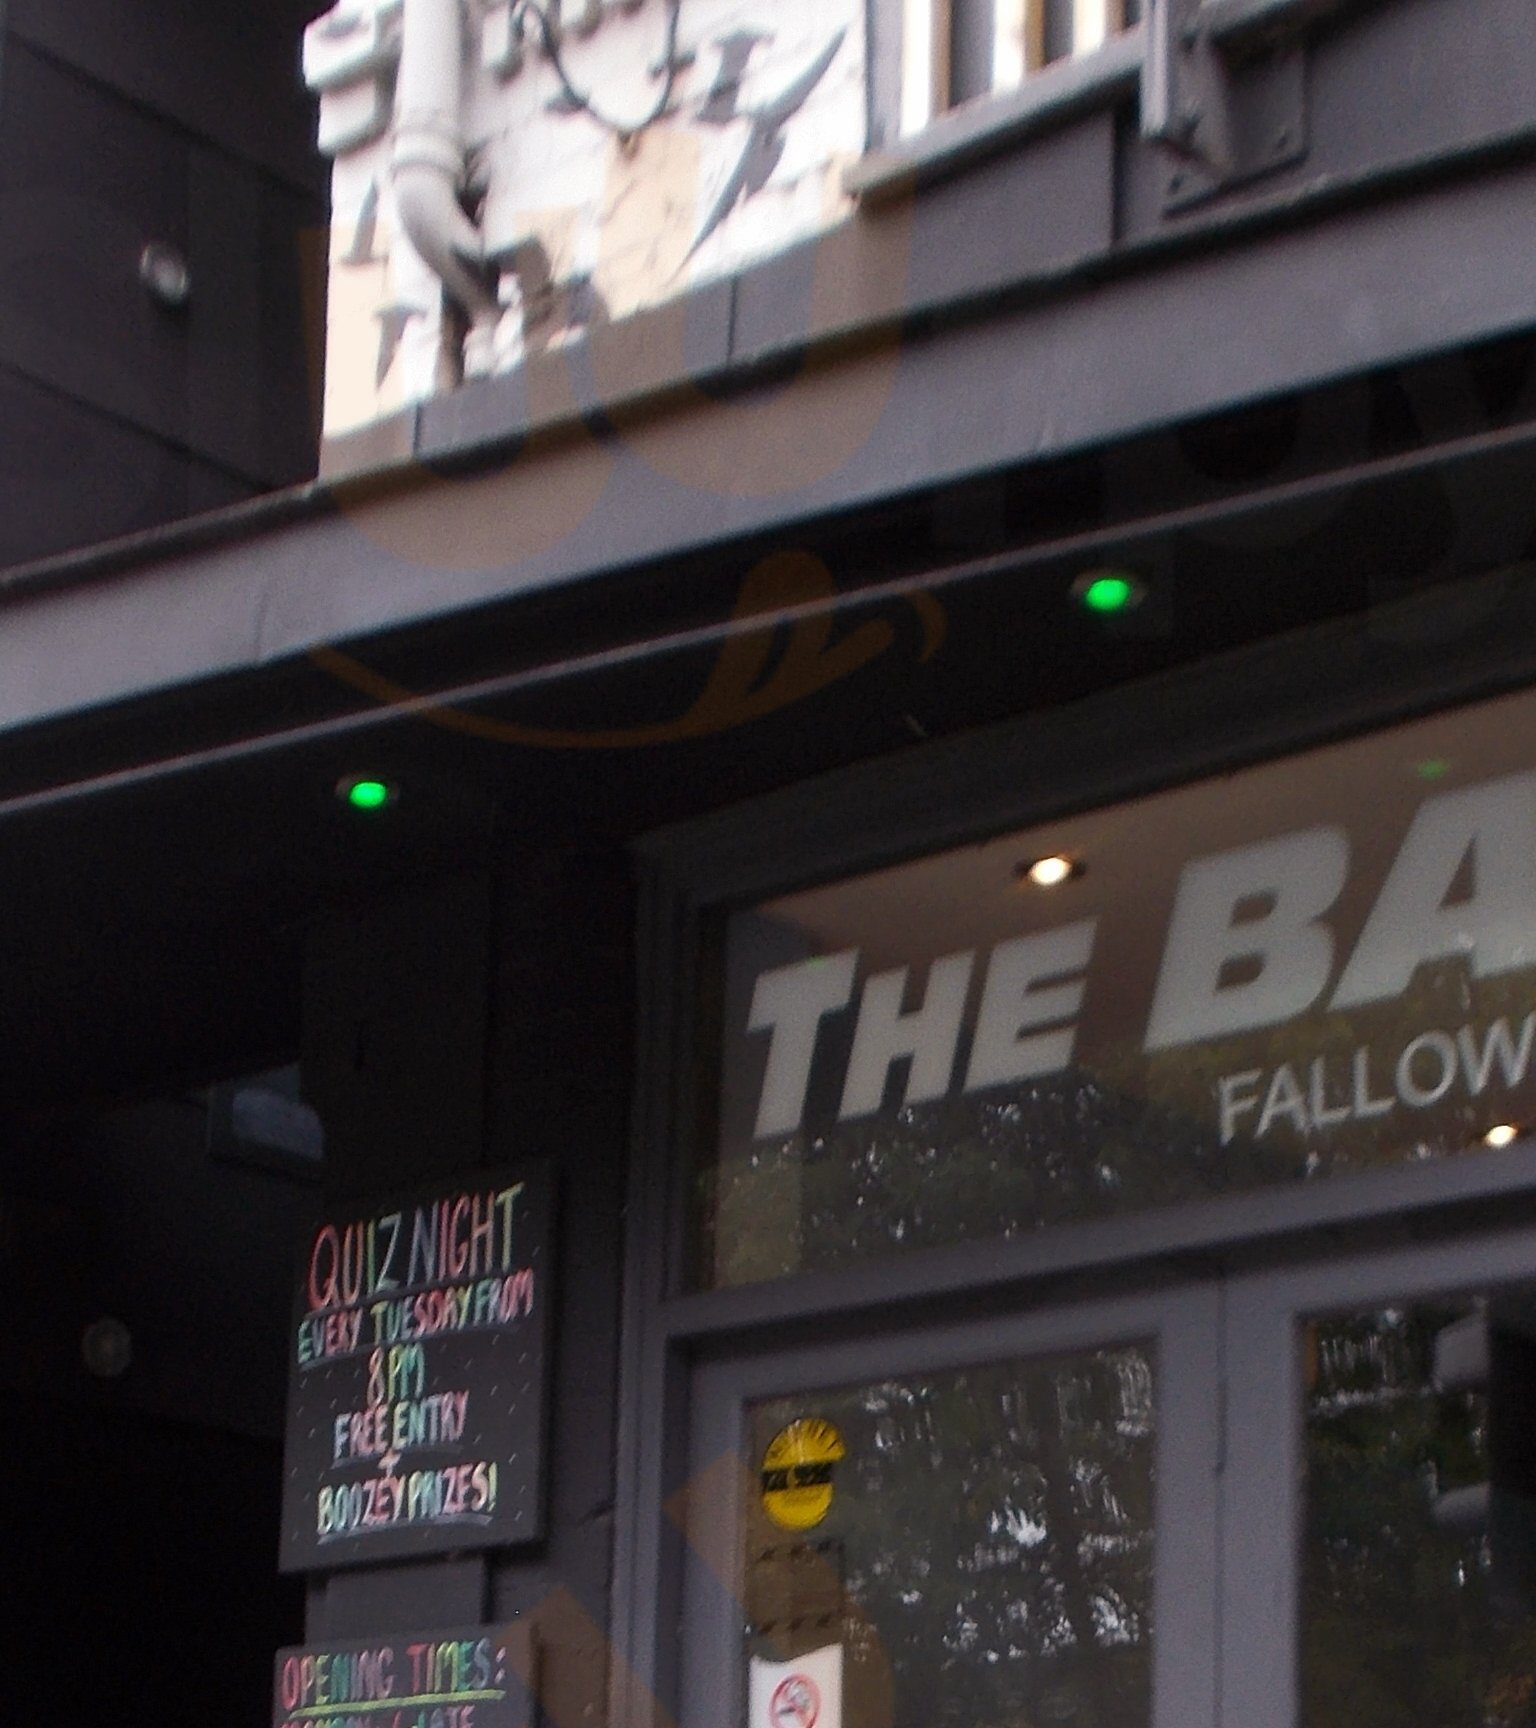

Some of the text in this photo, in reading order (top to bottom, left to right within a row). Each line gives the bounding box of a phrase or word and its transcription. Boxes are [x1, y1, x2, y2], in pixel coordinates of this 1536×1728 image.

[745, 918, 1096, 1140] THE
[309, 1182, 524, 1308] QUIZ NIGHT
[297, 1268, 534, 1364] EVERY TUESDAY FROM
[334, 1391, 469, 1460] FREE ENTRY
[281, 1638, 507, 1711] OPENING TIMES:
